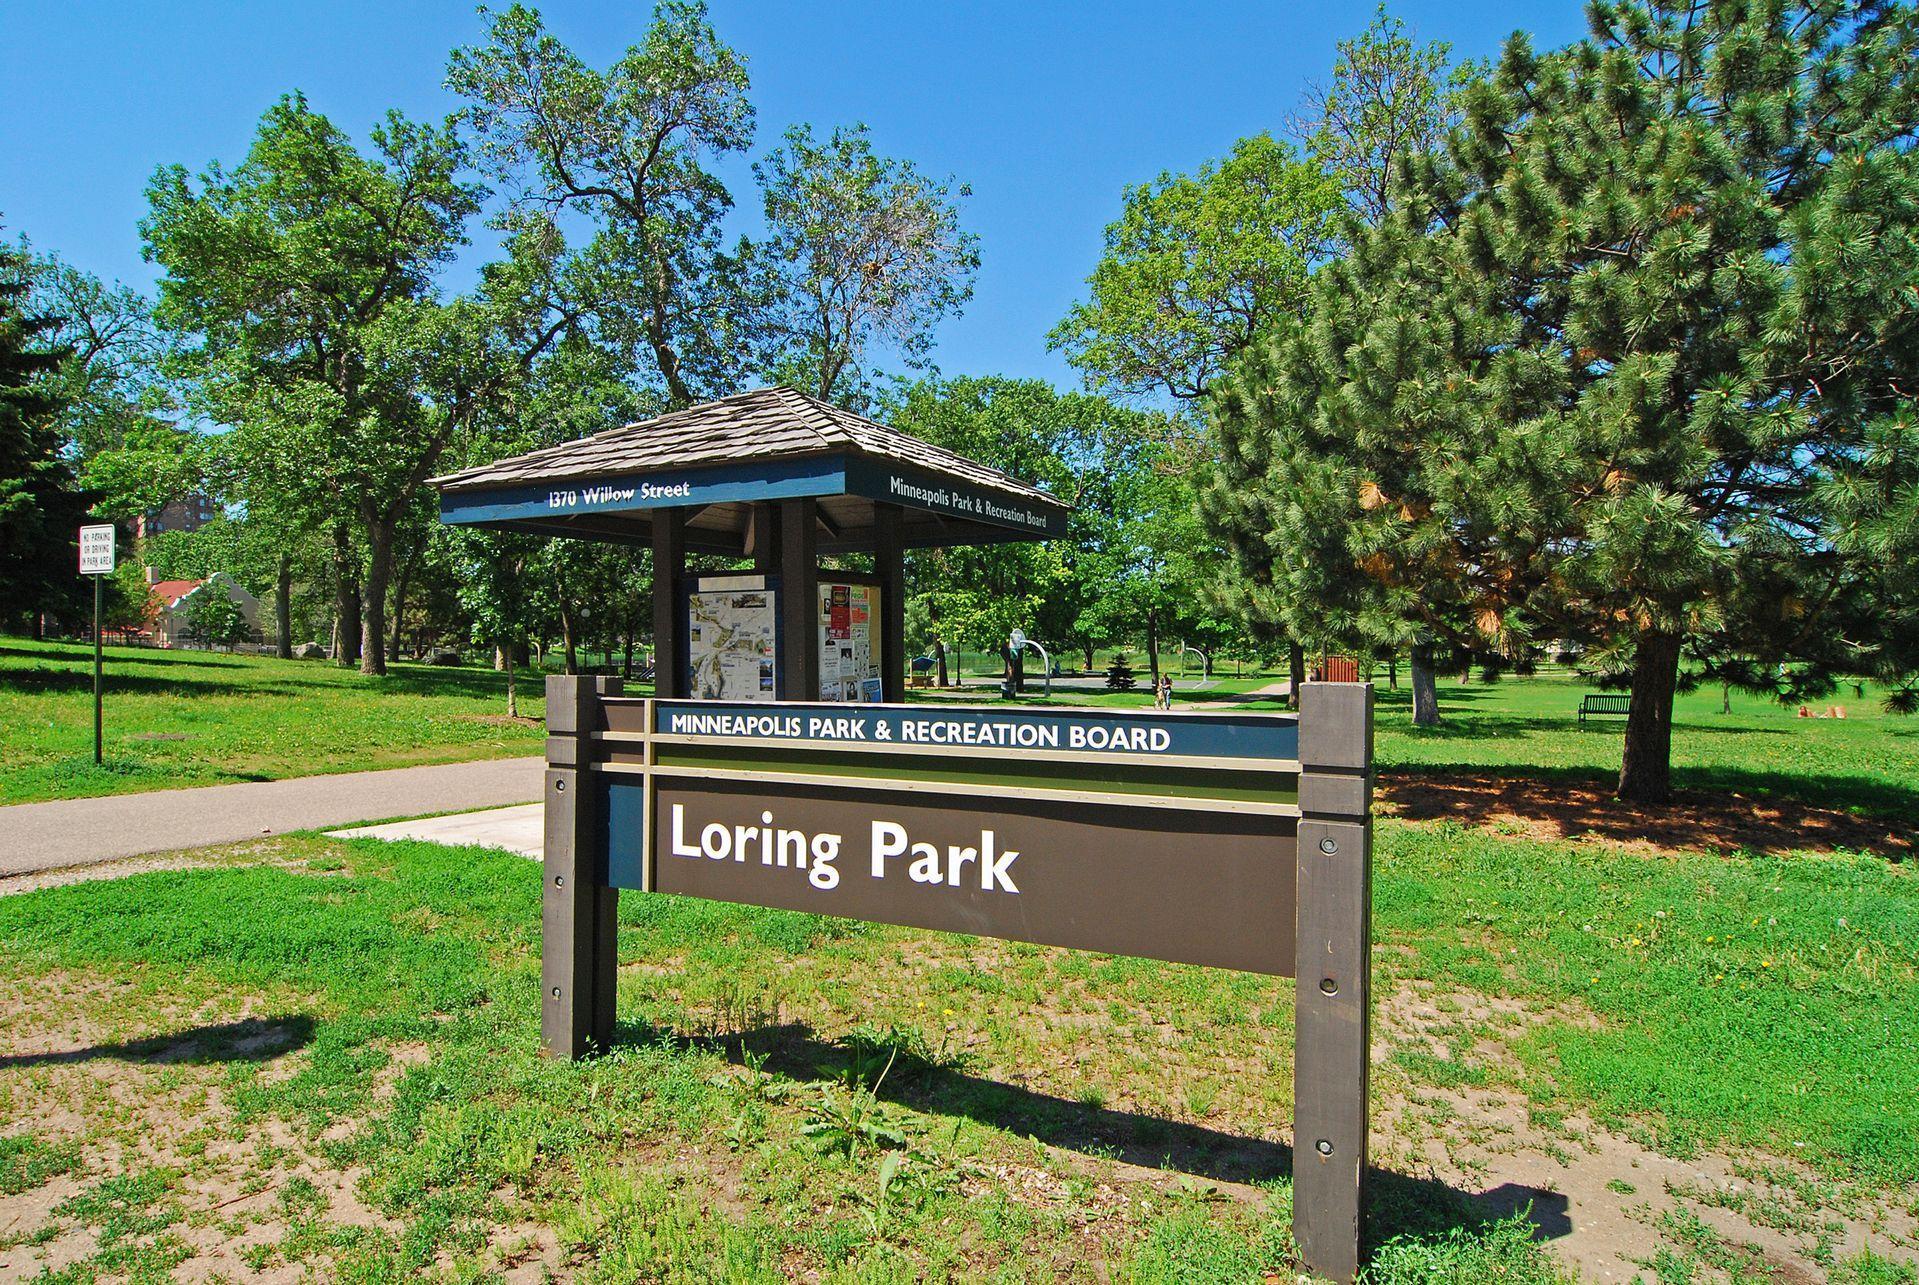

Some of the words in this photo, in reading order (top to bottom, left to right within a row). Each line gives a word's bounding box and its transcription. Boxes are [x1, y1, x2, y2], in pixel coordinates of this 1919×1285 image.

[549, 490, 577, 508] 1370
[582, 486, 635, 505] Willow
[641, 481, 690, 500] Street
[890, 475, 950, 506] Minneapolis
[952, 492, 973, 512] Park
[975, 498, 983, 514] &
[985, 500, 1025, 523] Recreation
[1027, 510, 1047, 528] Board
[83, 533, 90, 542] NO
[91, 532, 111, 542] PARKING
[84, 545, 90, 554] OR
[92, 544, 110, 553] DRIVING
[87, 557, 98, 566] PARK
[99, 556, 112, 566] AREA
[671, 714, 801, 737] MINNEAPOLIS
[809, 717, 866, 740] PARK
[874, 719, 892, 741] &
[901, 720, 1059, 747] RECREATION
[1069, 725, 1171, 752] BOARD
[672, 803, 842, 890] Loring
[871, 820, 1020, 894] Park
